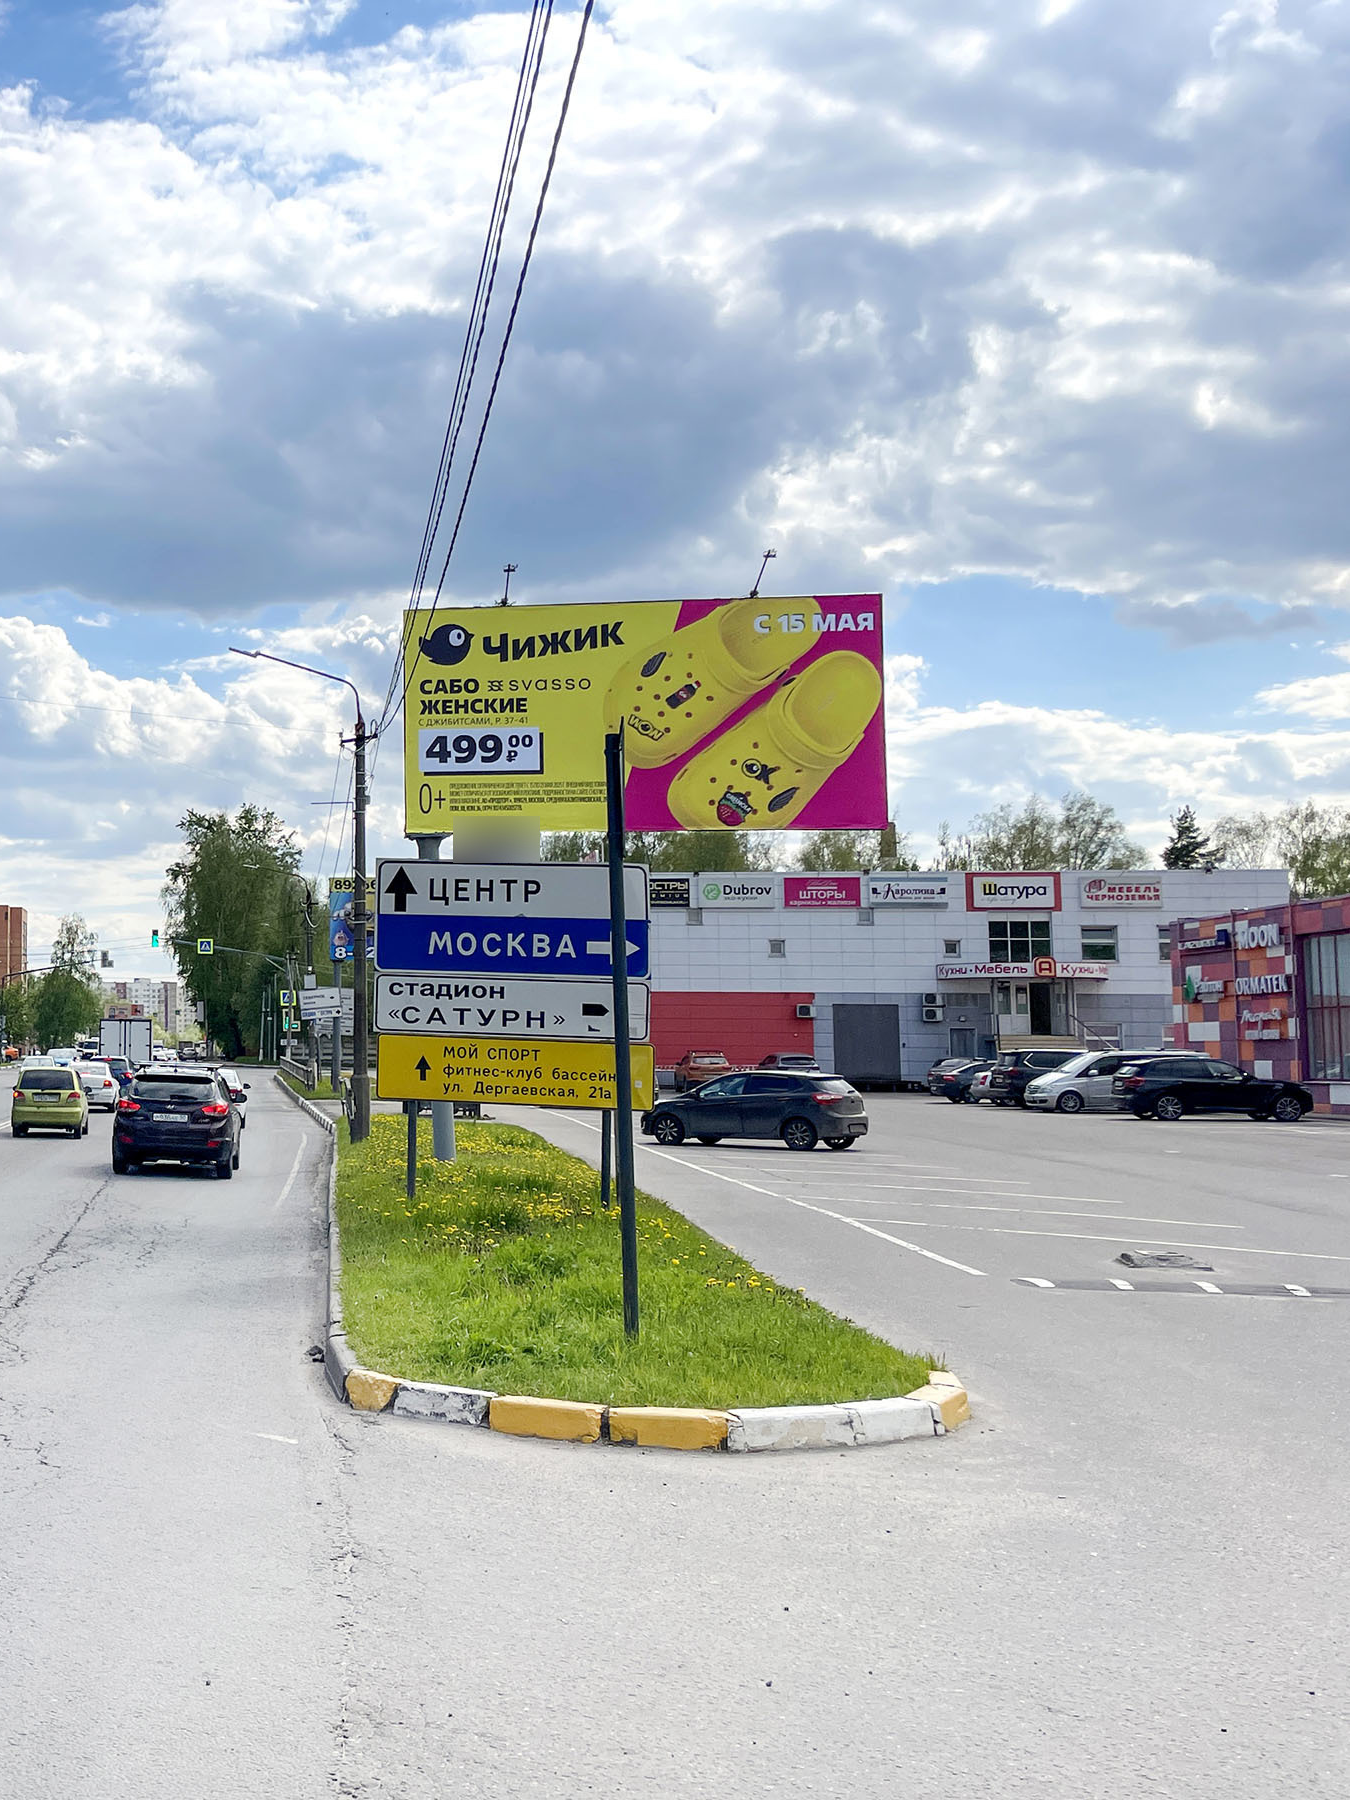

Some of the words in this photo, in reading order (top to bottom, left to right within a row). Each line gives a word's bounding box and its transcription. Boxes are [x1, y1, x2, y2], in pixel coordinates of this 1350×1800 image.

[754, 613, 772, 634] С
[778, 613, 806, 633] 15
[812, 611, 875, 632] МАЯ
[419, 678, 480, 695] САБО
[508, 677, 592, 691] svasso
[419, 697, 528, 716] ЖЕНСКИЕ
[426, 717, 493, 728] ДЖИБИТСАМИ,
[504, 716, 529, 725] 37-41
[425, 734, 503, 763] 499
[419, 783, 447, 814] 0+
[429, 878, 542, 906] ЦЕНТР
[723, 884, 771, 895] Dubrov
[799, 891, 846, 899] ШТОРЫ
[883, 883, 936, 900] Каролина
[982, 882, 1047, 899] Шатура
[428, 931, 577, 959] МОСКВА
[1237, 923, 1280, 950] MOON
[939, 965, 967, 977] Кухни
[974, 964, 1028, 974] Мебель
[1061, 964, 1094, 976] Кухни
[389, 982, 505, 1000] стадион
[1236, 974, 1287, 995] ORMATEK
[388, 1006, 566, 1029] «САТУРН»
[443, 1043, 478, 1059] МОЙ
[487, 1047, 541, 1061] СПОРТ
[443, 1064, 542, 1081] фитнес-клуб
[552, 1067, 616, 1082] бассейн
[443, 1083, 464, 1095] ул.
[473, 1081, 579, 1098] Дергаевская,
[588, 1086, 612, 1099] 21а
